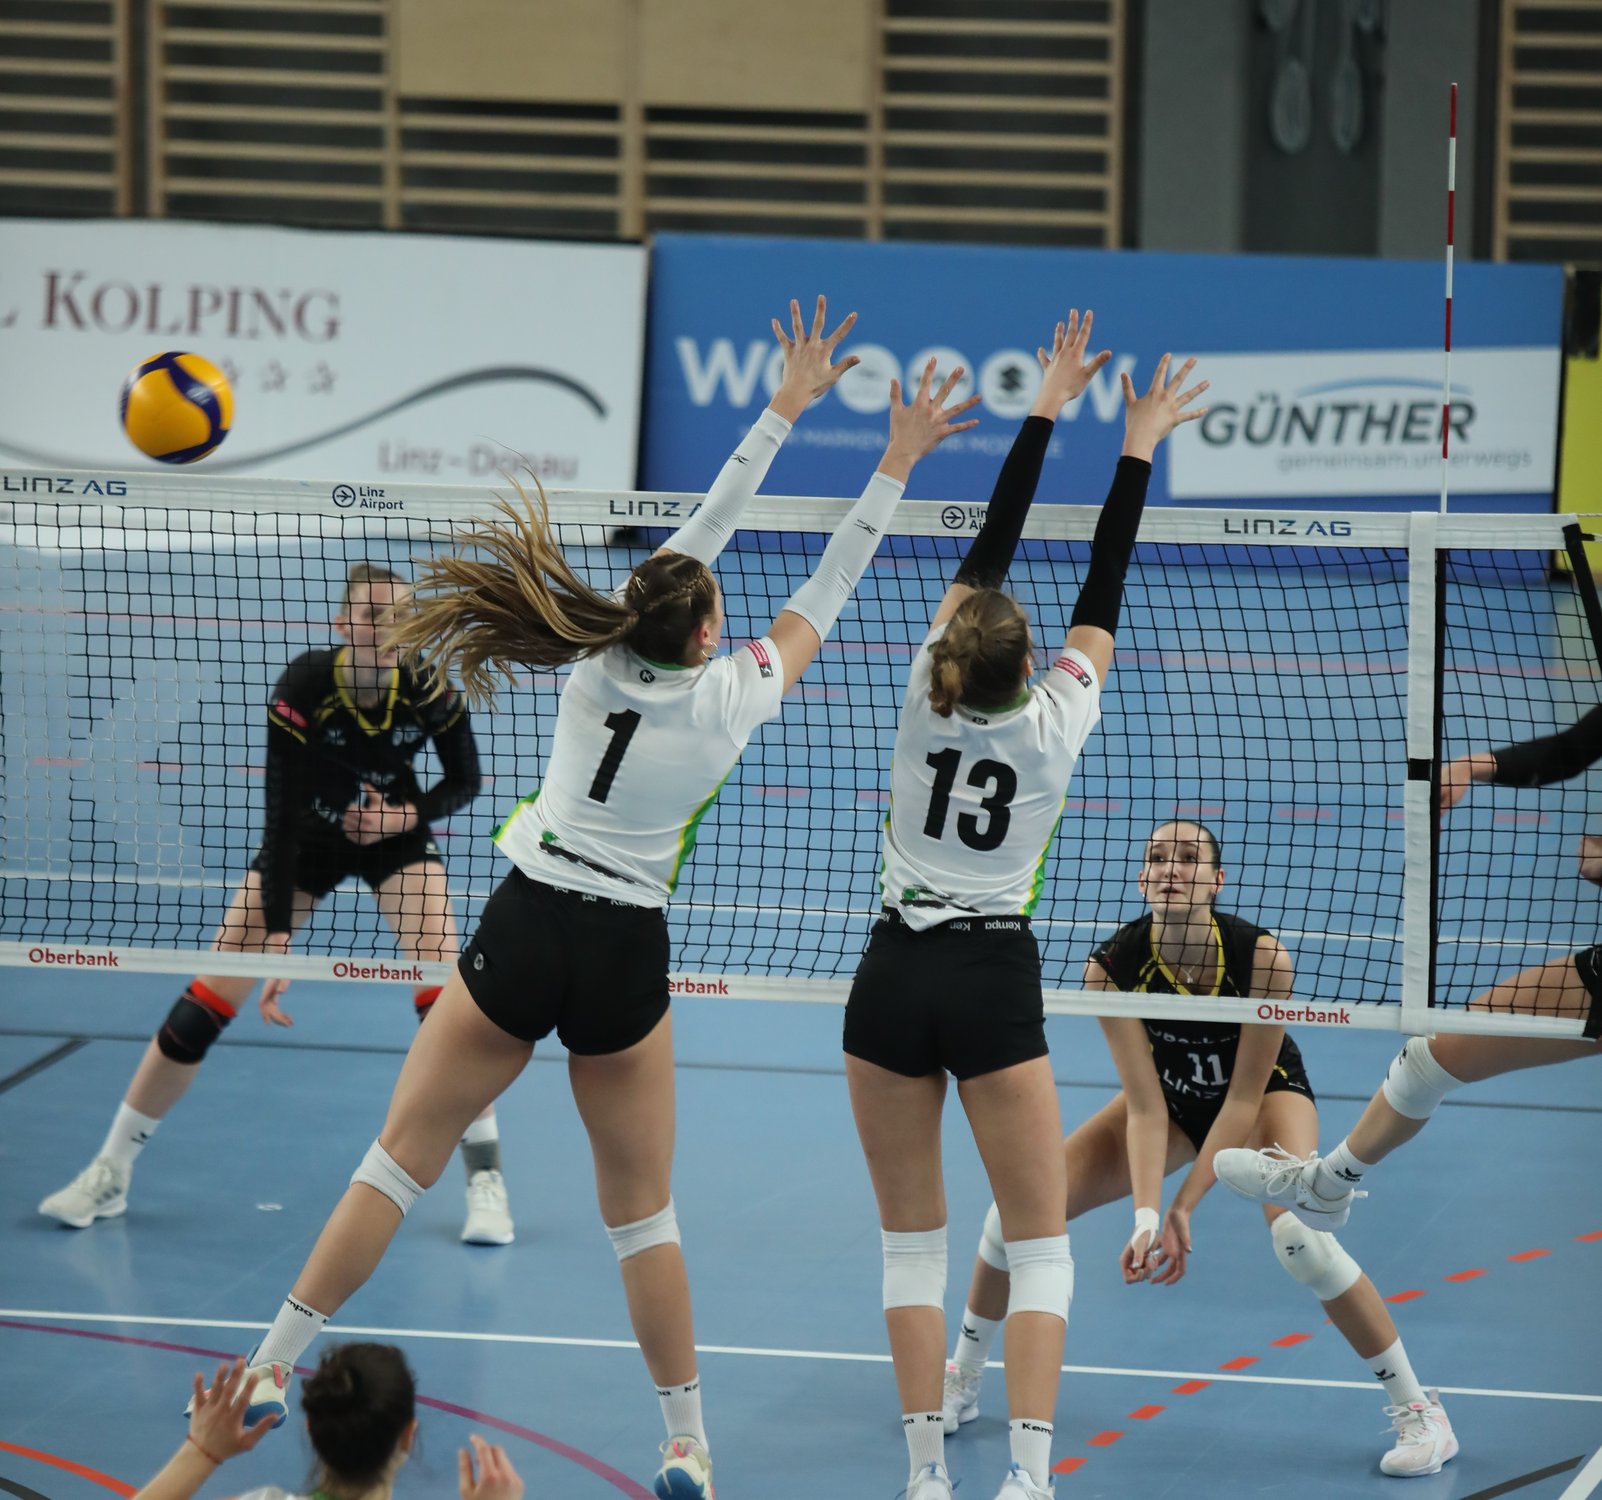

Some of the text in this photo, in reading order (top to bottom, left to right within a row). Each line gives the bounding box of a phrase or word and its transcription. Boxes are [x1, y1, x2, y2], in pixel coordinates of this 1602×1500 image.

[42, 269, 341, 343] KOLPING
[1200, 390, 1476, 448] GÜNTHER
[378, 440, 442, 474] Linz
[4, 476, 127, 496] LINZ AG
[360, 486, 385, 498] Linz
[360, 499, 404, 512] Airport
[609, 500, 681, 517] LINZ
[1224, 518, 1352, 536] LINZ AG
[588, 708, 642, 805] 1
[923, 747, 1018, 852] 13
[28, 947, 119, 967] Oberbank
[333, 962, 423, 981] Oberbank
[667, 977, 729, 995] erbank
[1257, 1004, 1351, 1024] Oberbank
[1187, 1052, 1229, 1086] 11
